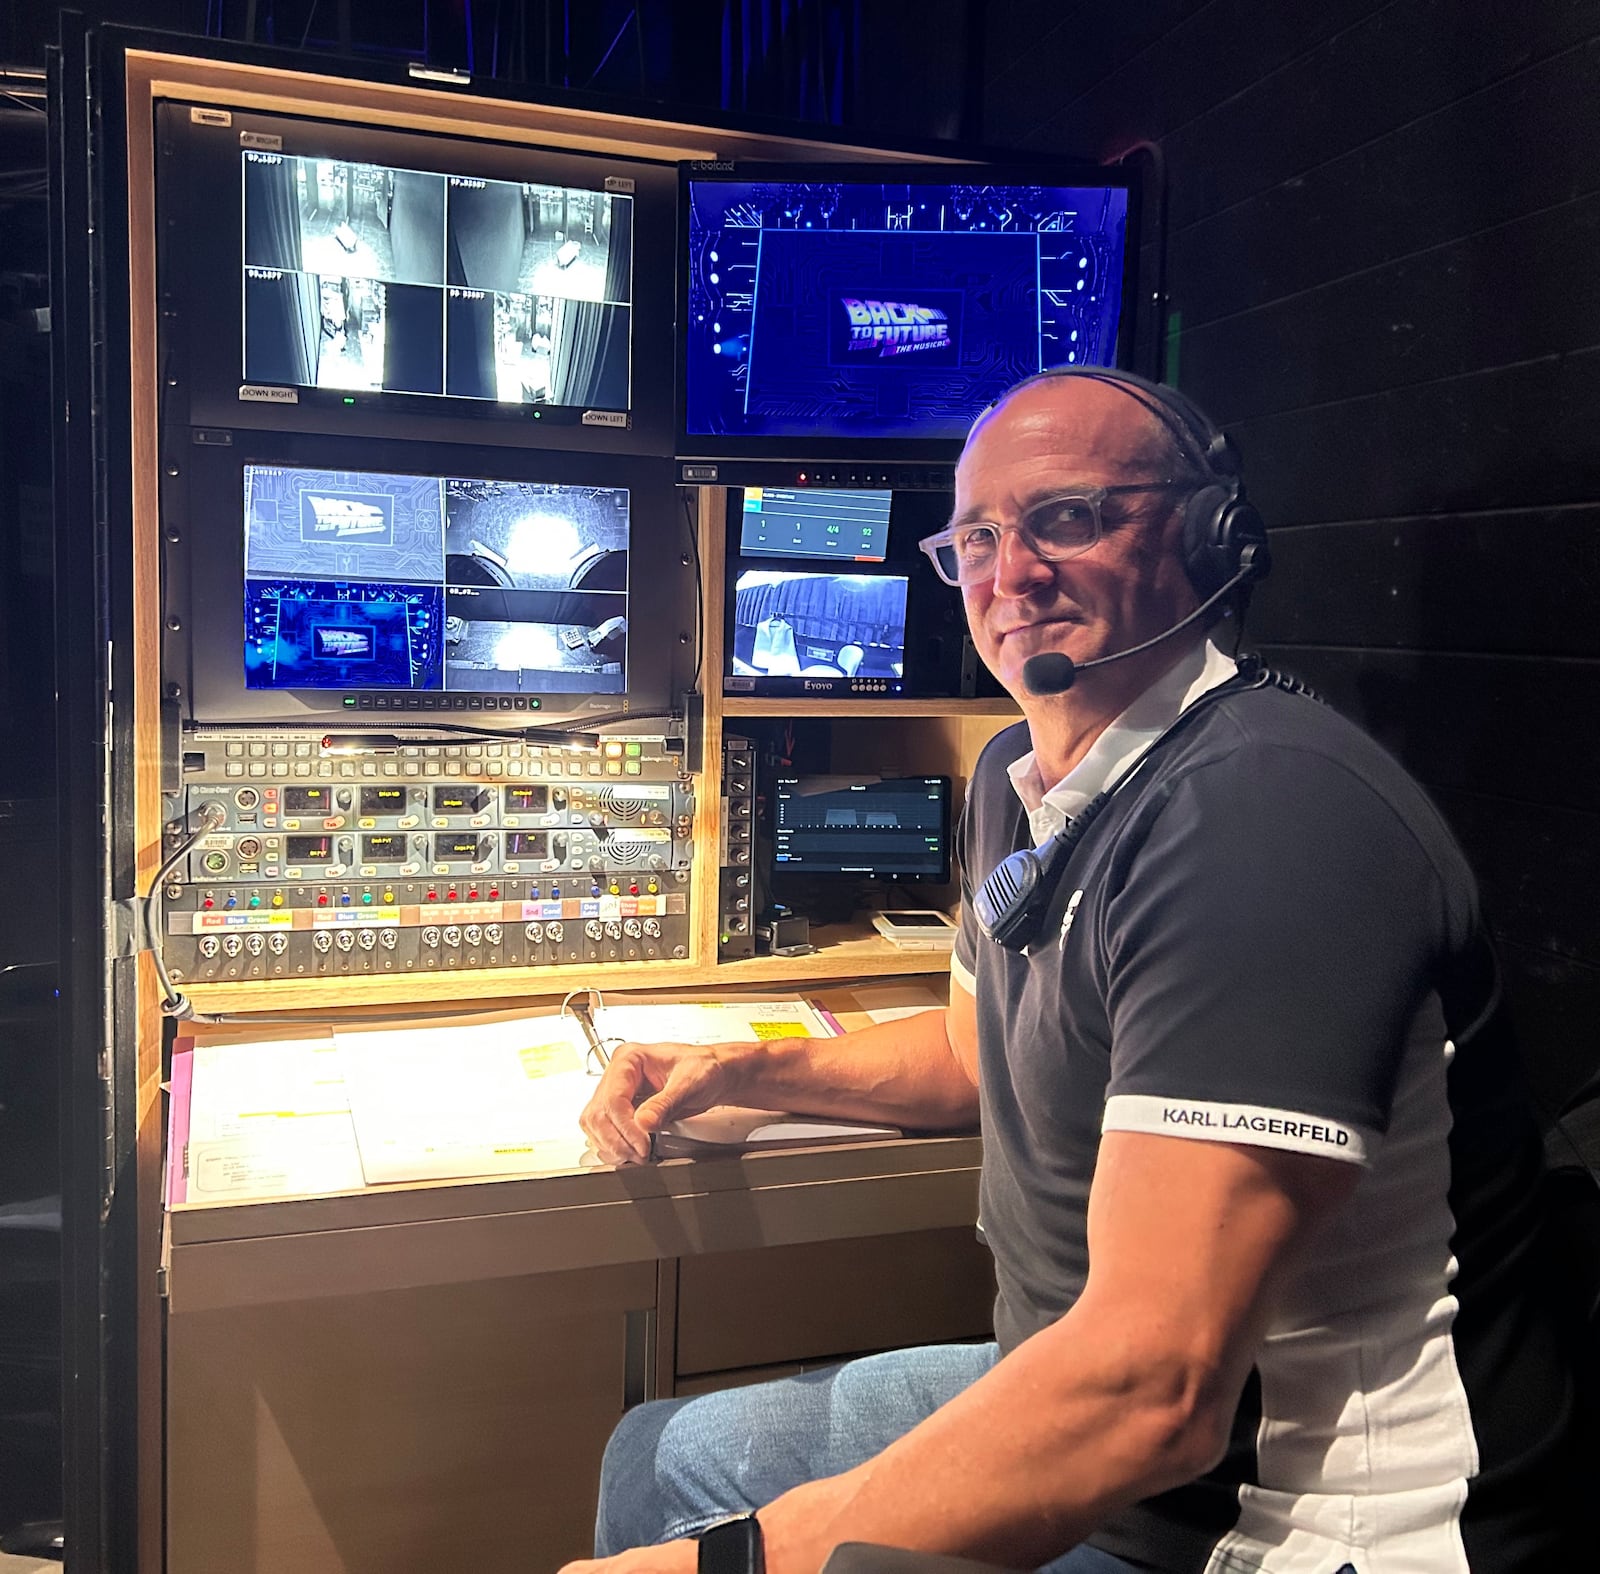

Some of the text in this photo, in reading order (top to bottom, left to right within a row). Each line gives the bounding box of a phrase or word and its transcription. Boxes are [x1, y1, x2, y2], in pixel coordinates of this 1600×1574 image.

[841, 298, 932, 325] BACK
[851, 324, 948, 347] TO FUTURE
[896, 340, 947, 354] THE MUSICAL
[242, 389, 269, 397] DOWN
[760, 519, 767, 528] 1
[795, 522, 801, 531] 1
[826, 525, 840, 534] 4/4
[543, 907, 561, 915] Cond
[246, 916, 270, 924] Green
[1163, 1108, 1349, 1146] KARL LAGERFELD
